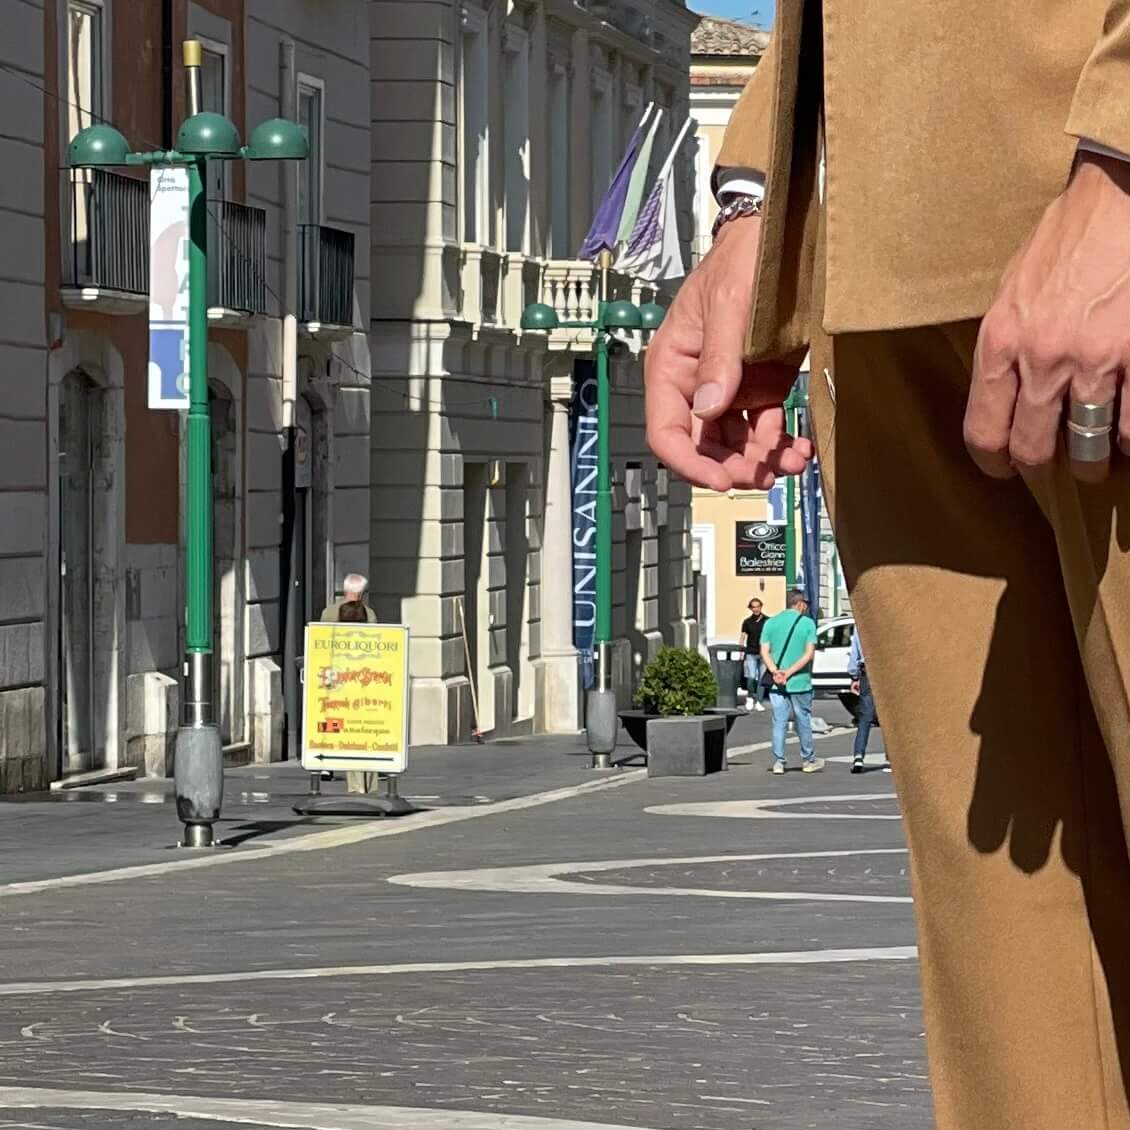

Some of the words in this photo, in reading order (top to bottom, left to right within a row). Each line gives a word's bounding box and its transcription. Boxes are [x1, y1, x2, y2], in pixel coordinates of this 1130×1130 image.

[573, 378, 599, 628] UNISANNIO
[739, 556, 785, 568] Balestrier
[314, 639, 399, 652] EUROLIQUORI
